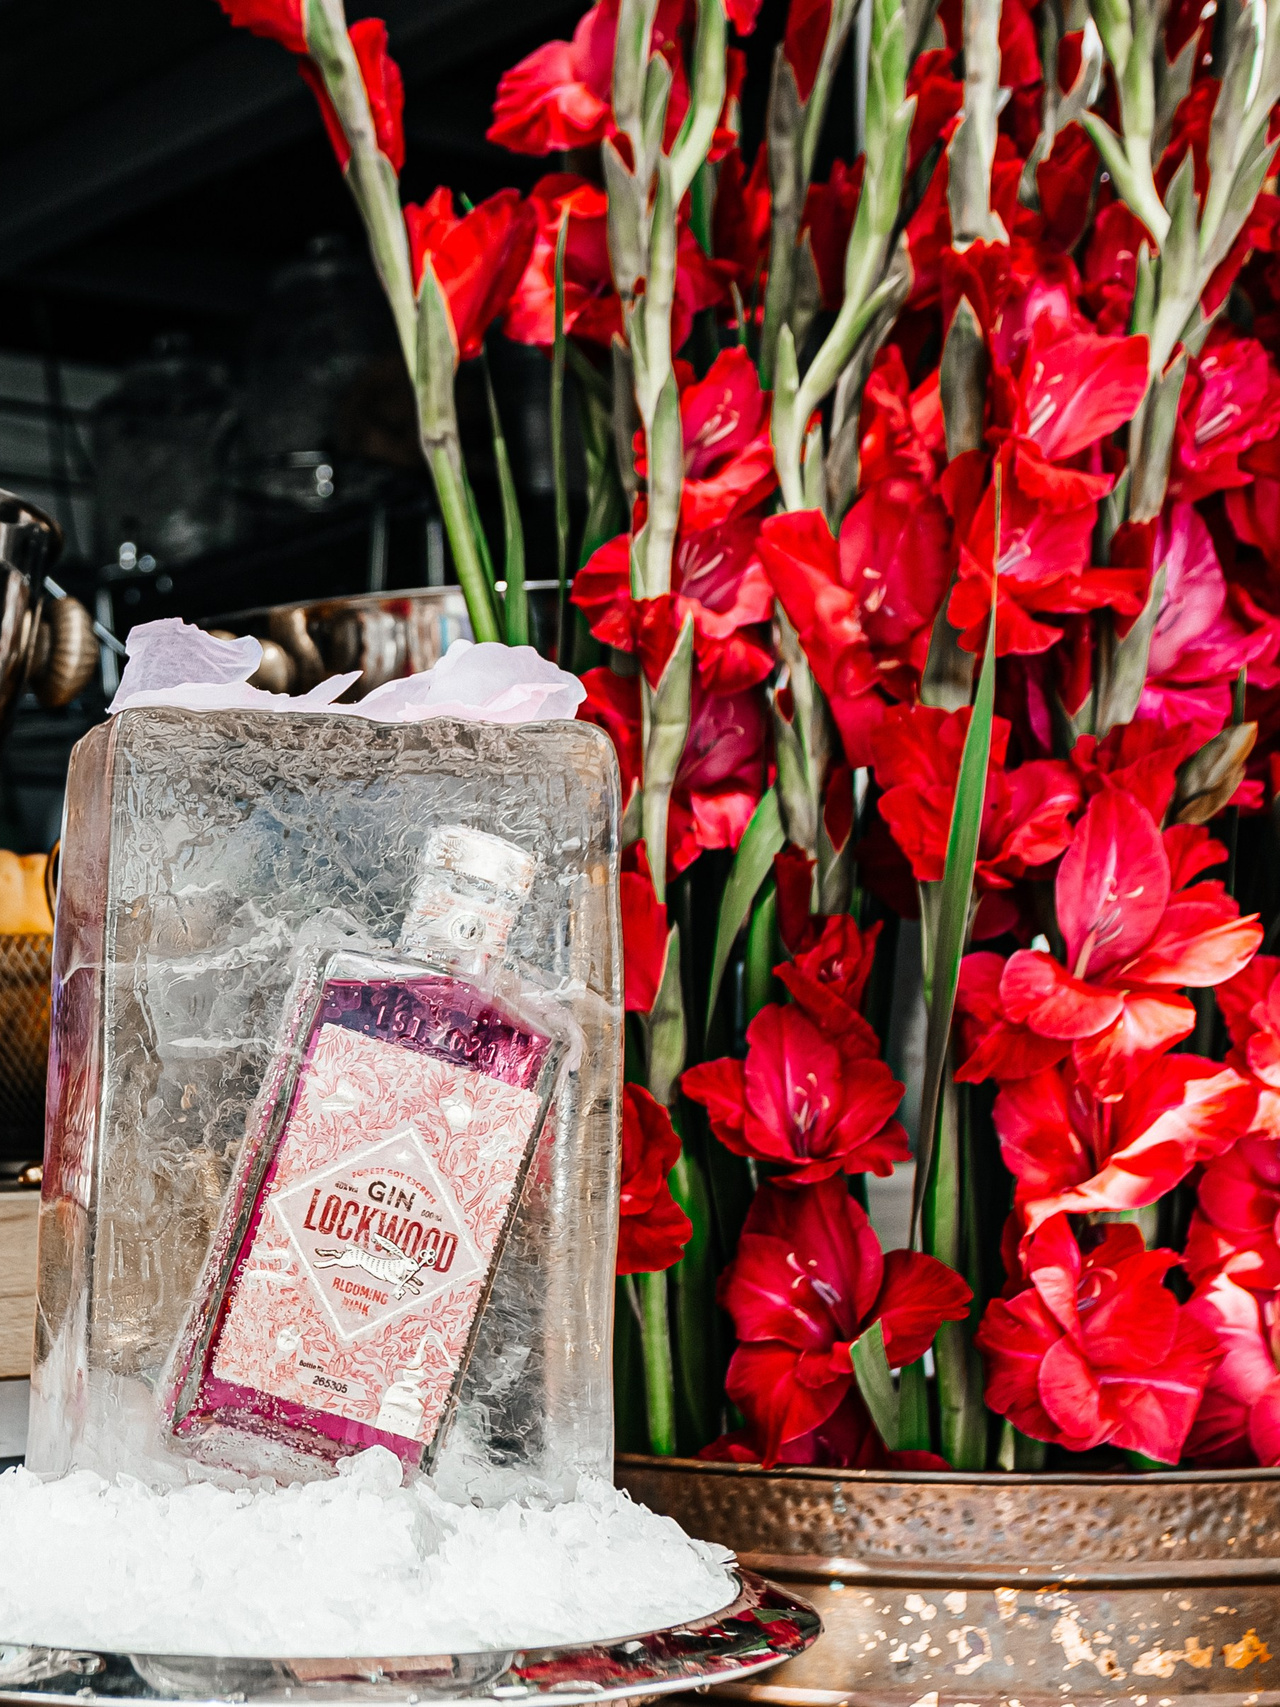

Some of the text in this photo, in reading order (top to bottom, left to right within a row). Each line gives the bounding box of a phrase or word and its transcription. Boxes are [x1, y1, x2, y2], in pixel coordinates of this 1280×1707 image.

[387, 1169, 405, 1180] GOT
[368, 1180, 415, 1211] GIN
[303, 1188, 459, 1273] LOCKWOOD
[313, 1375, 348, 1393] 265305
